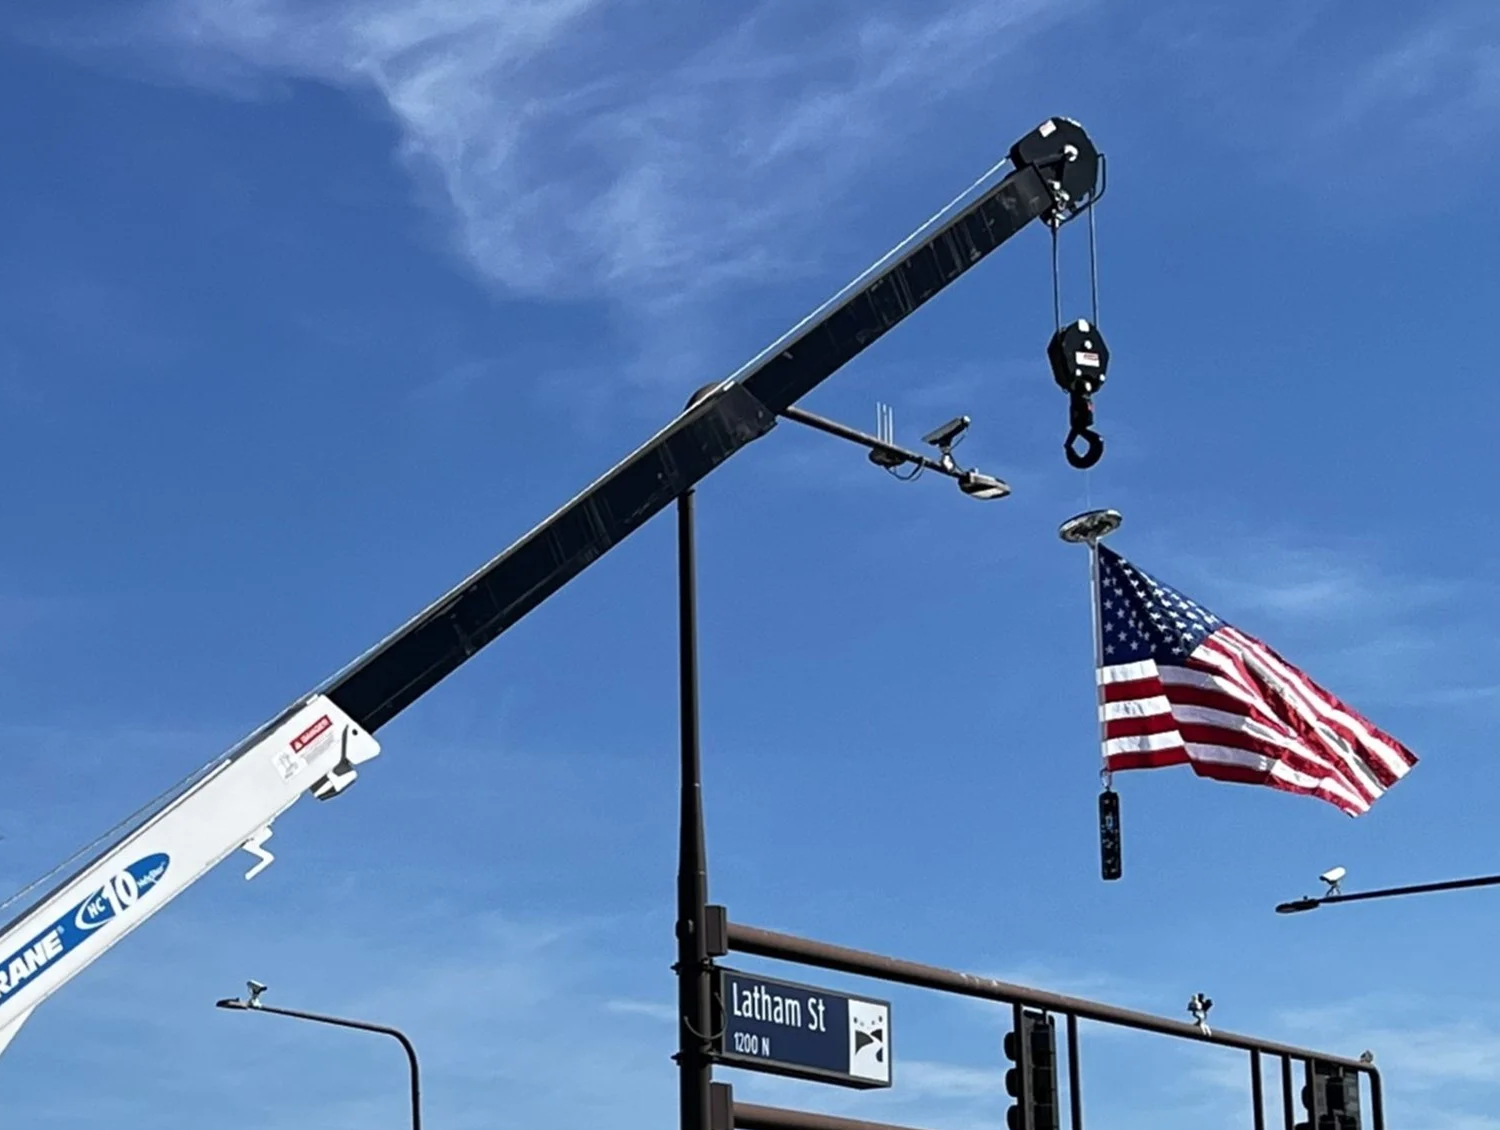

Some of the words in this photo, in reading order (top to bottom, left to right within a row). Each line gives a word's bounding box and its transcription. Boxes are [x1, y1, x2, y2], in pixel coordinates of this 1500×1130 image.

[87, 896, 106, 919] HC
[101, 870, 139, 915] 10
[732, 982, 801, 1028] Latham
[807, 997, 826, 1032] St
[734, 1031, 759, 1055] 1200
[762, 1036, 770, 1057] N
